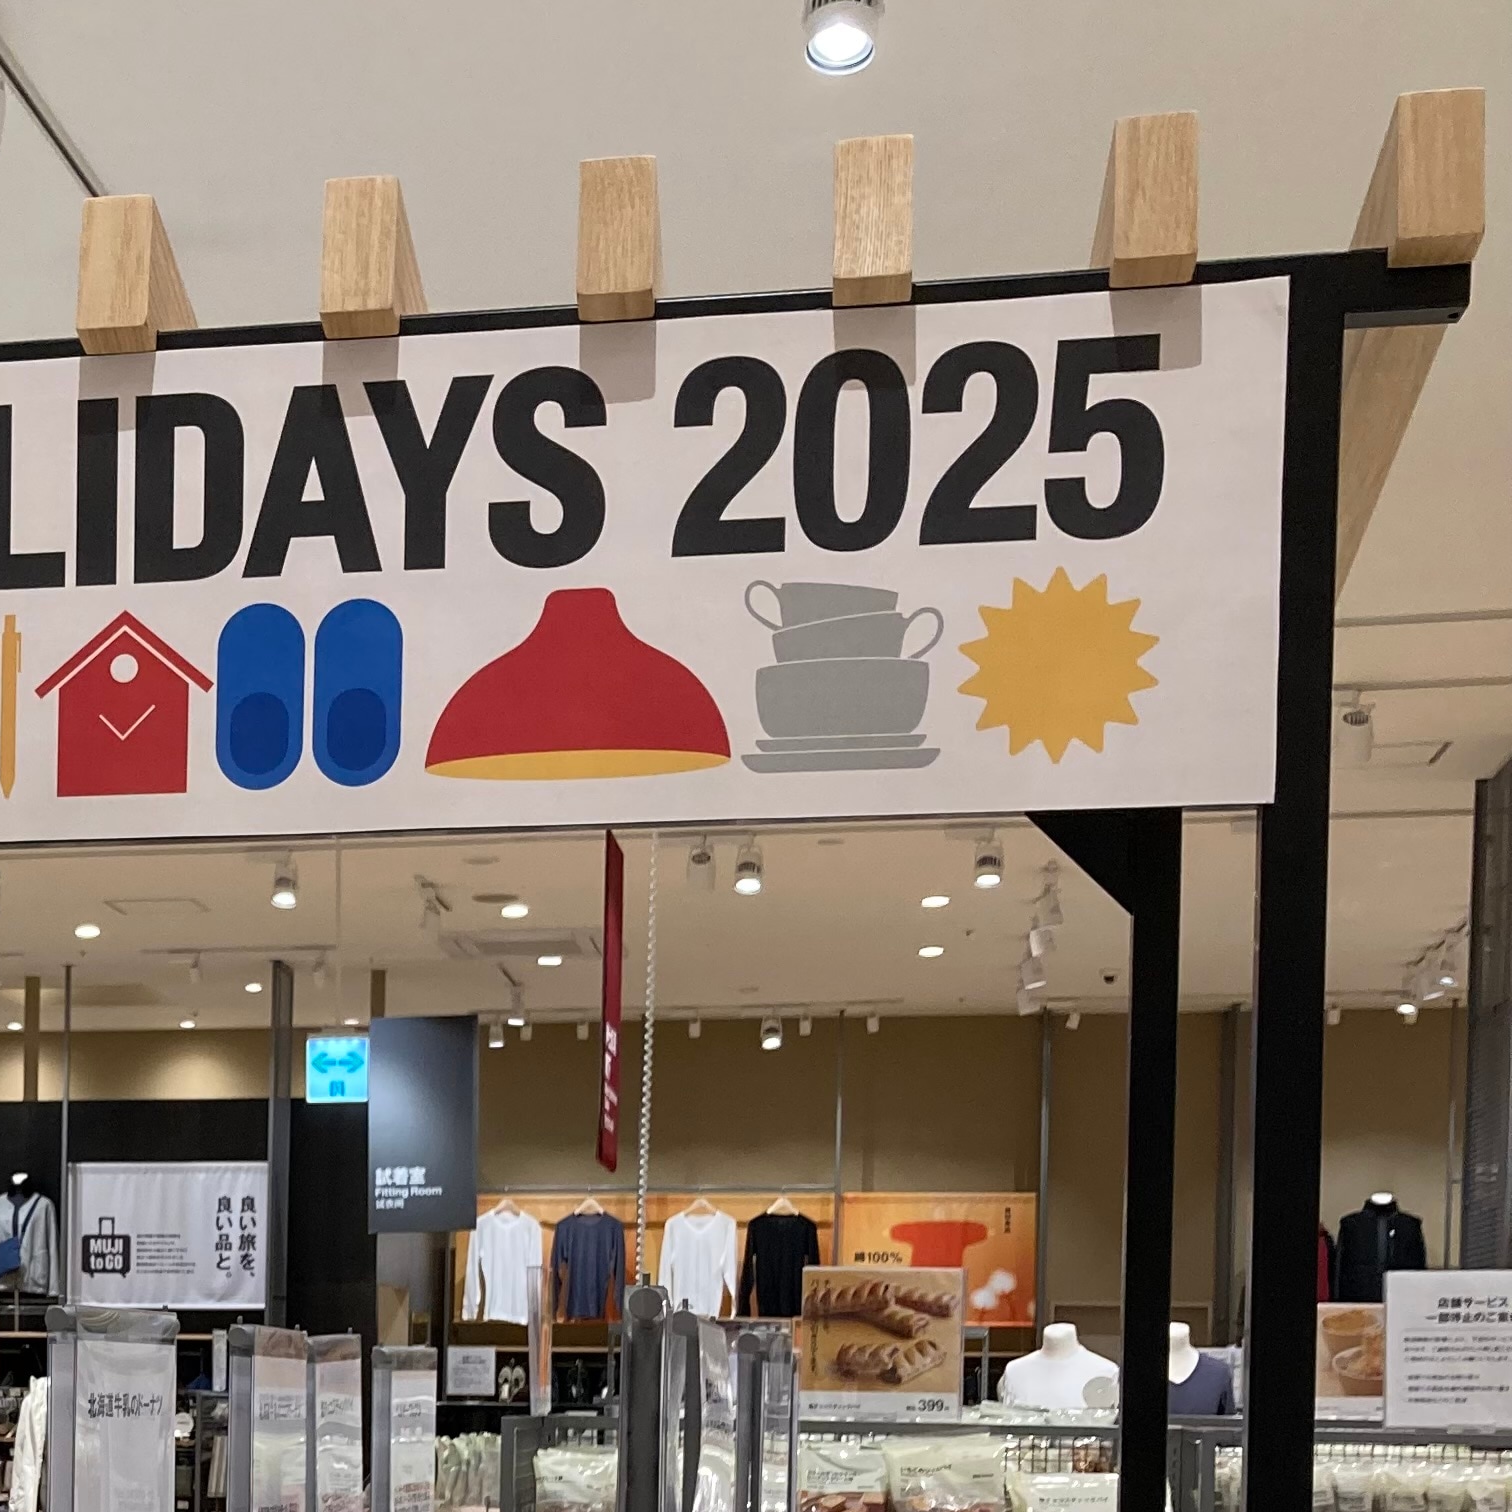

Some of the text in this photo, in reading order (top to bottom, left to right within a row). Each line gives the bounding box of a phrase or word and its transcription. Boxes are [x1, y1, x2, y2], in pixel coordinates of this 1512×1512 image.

[673, 333, 1166, 558] 2025
[375, 1186, 443, 1199] Fitting Room
[90, 1238, 124, 1254] MUJI
[215, 1196, 233, 1278] 良い品と。
[238, 1196, 257, 1277] 良い旅を、
[88, 1393, 164, 1418] 北海道牛乳のドーナツ
